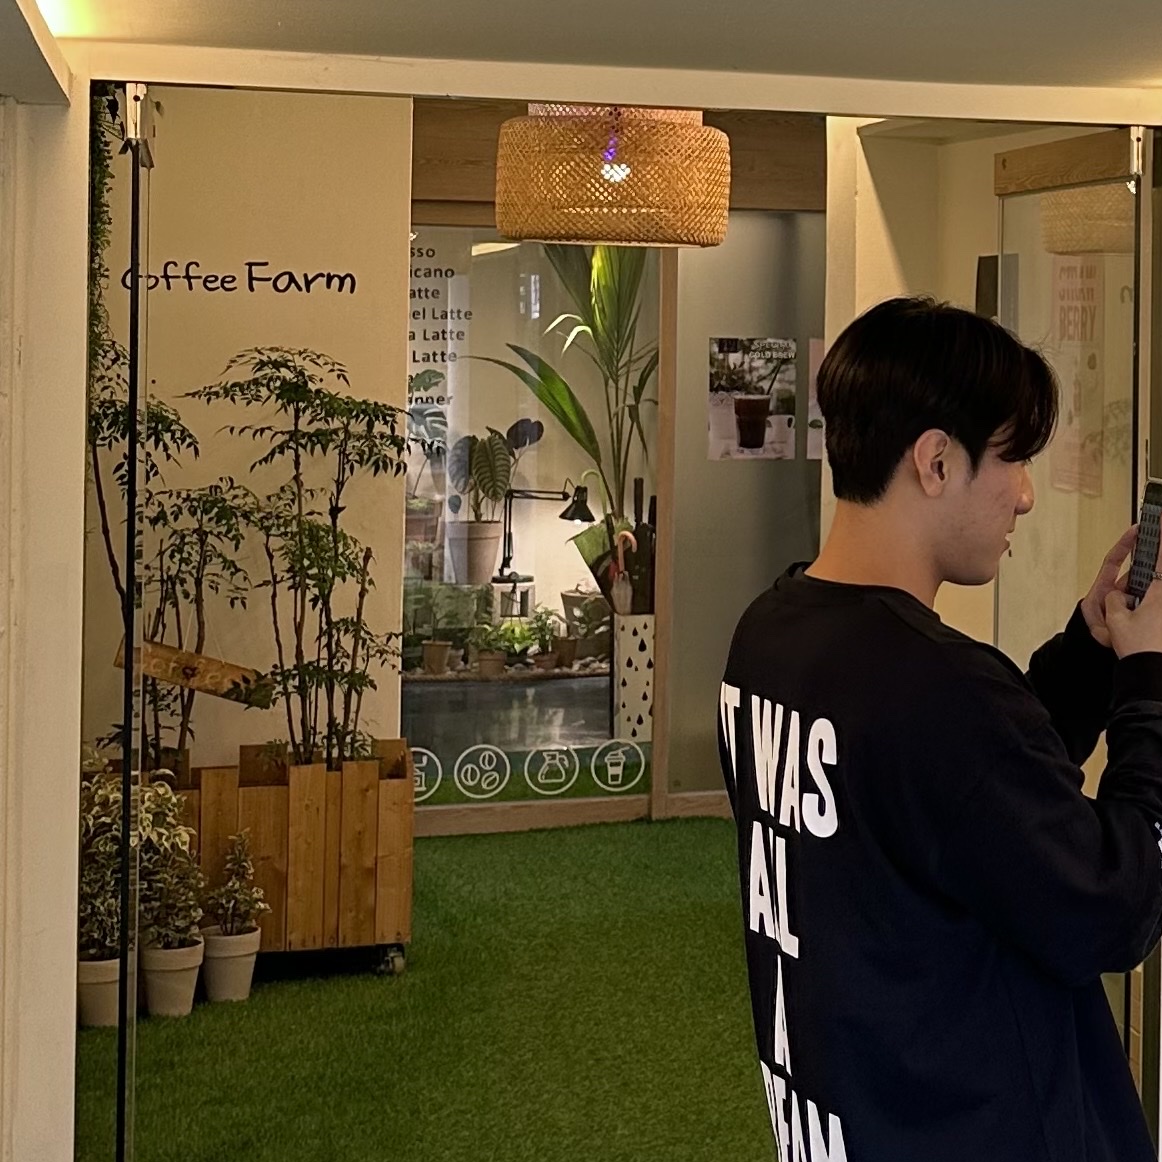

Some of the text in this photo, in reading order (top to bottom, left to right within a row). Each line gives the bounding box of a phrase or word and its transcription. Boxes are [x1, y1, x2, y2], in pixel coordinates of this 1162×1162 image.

[245, 261, 357, 295] Farm
[431, 307, 473, 320] Latte
[1059, 304, 1097, 341] BERRY
[422, 328, 465, 341] Latte
[412, 350, 458, 363] Latte
[751, 693, 839, 839] WAS
[774, 954, 792, 1077] A
